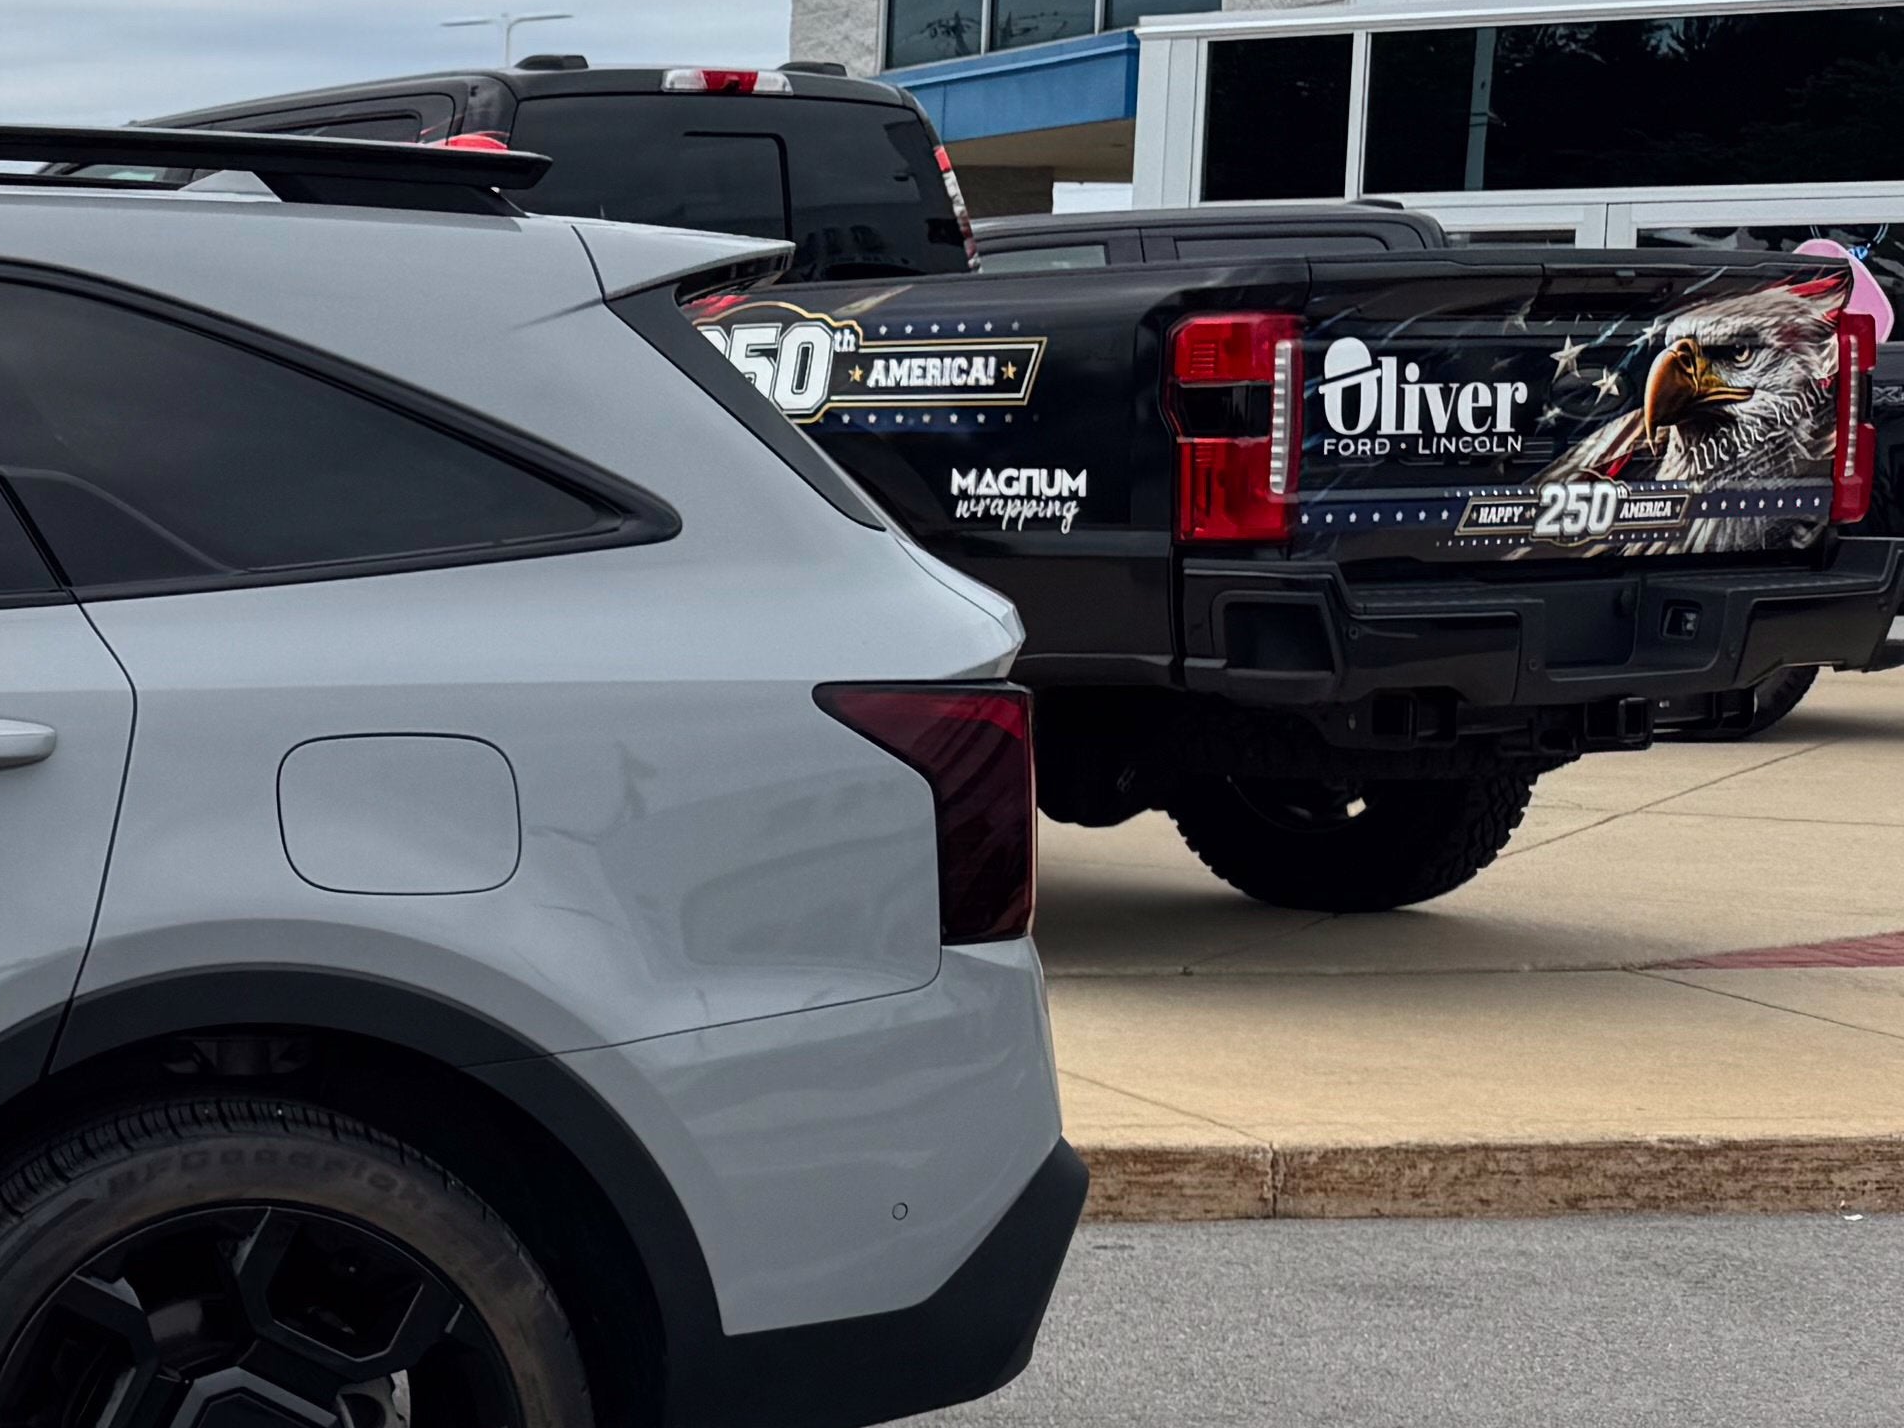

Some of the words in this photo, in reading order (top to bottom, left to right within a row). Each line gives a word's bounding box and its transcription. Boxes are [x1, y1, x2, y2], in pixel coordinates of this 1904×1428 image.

[866, 356, 996, 388] AMERICA!
[1318, 336, 1528, 436] Oliver
[1323, 438, 1391, 456] FORD
[1418, 435, 1523, 455] LINCOLN
[950, 467, 1088, 497] MAGNUM
[955, 495, 1080, 534] wrapping
[1478, 506, 1524, 523] HAPPY
[1620, 501, 1672, 519] AMERICA
